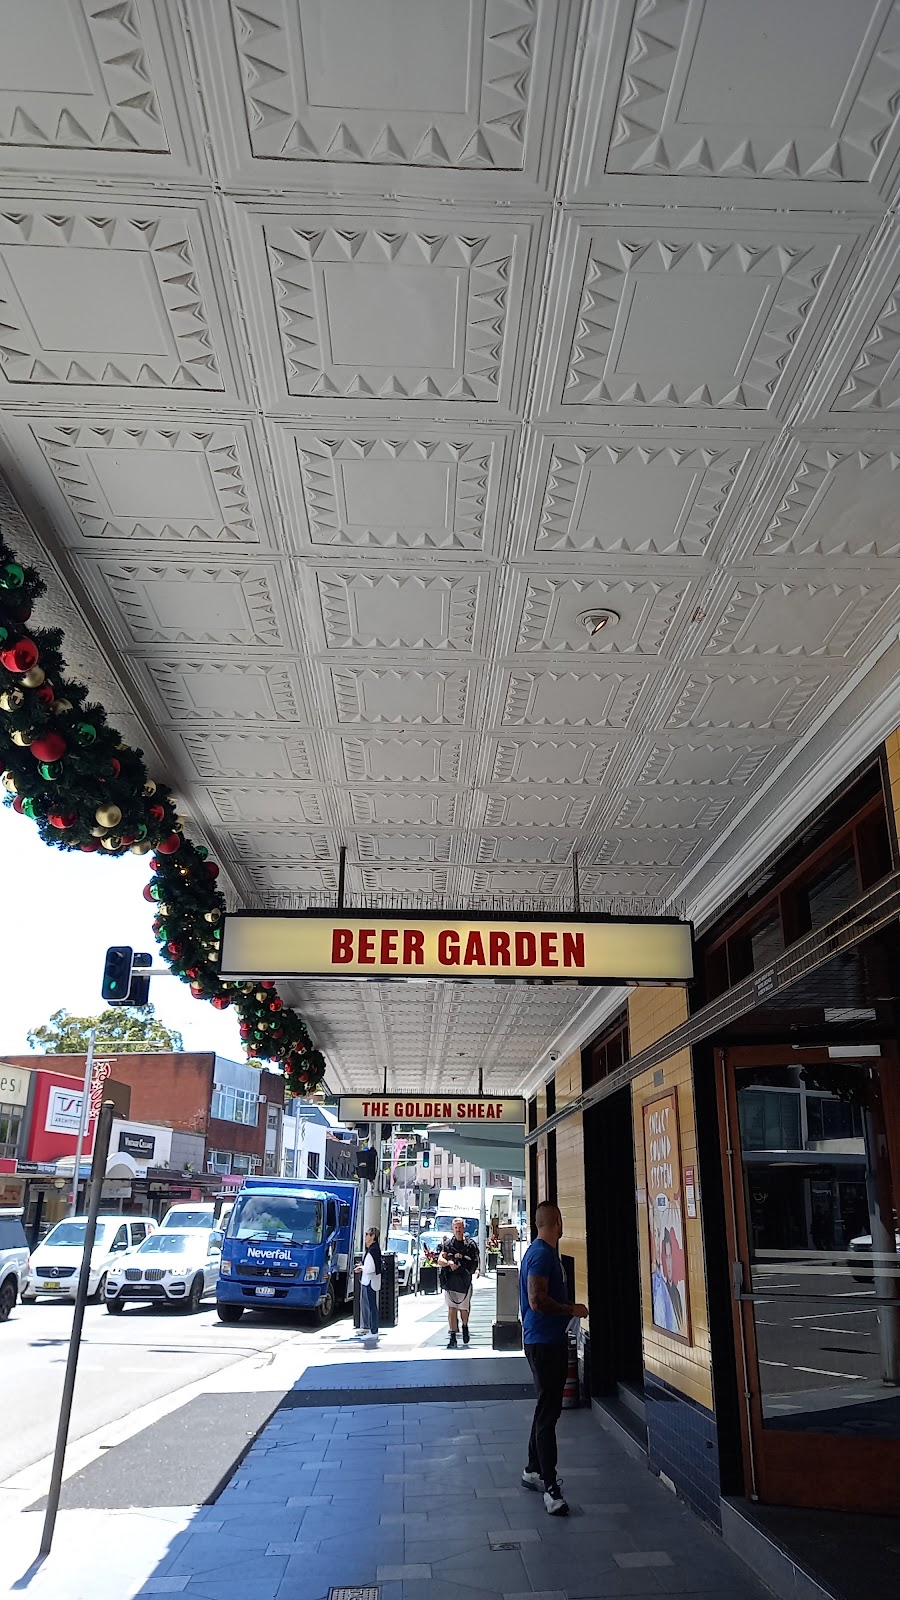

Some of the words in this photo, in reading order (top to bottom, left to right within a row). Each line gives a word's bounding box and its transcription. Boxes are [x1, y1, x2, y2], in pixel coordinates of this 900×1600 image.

[331, 928, 426, 966] BEER
[437, 929, 586, 969] GARDEN
[362, 1102, 389, 1117] THE
[394, 1102, 452, 1118] GOLDEN
[457, 1103, 503, 1119] SHEAF
[650, 1136, 671, 1162] SOUND
[651, 1163, 672, 1189] SYSTEM
[240, 1259, 298, 1268] FUSO
[247, 1247, 292, 1260] Neverfail
